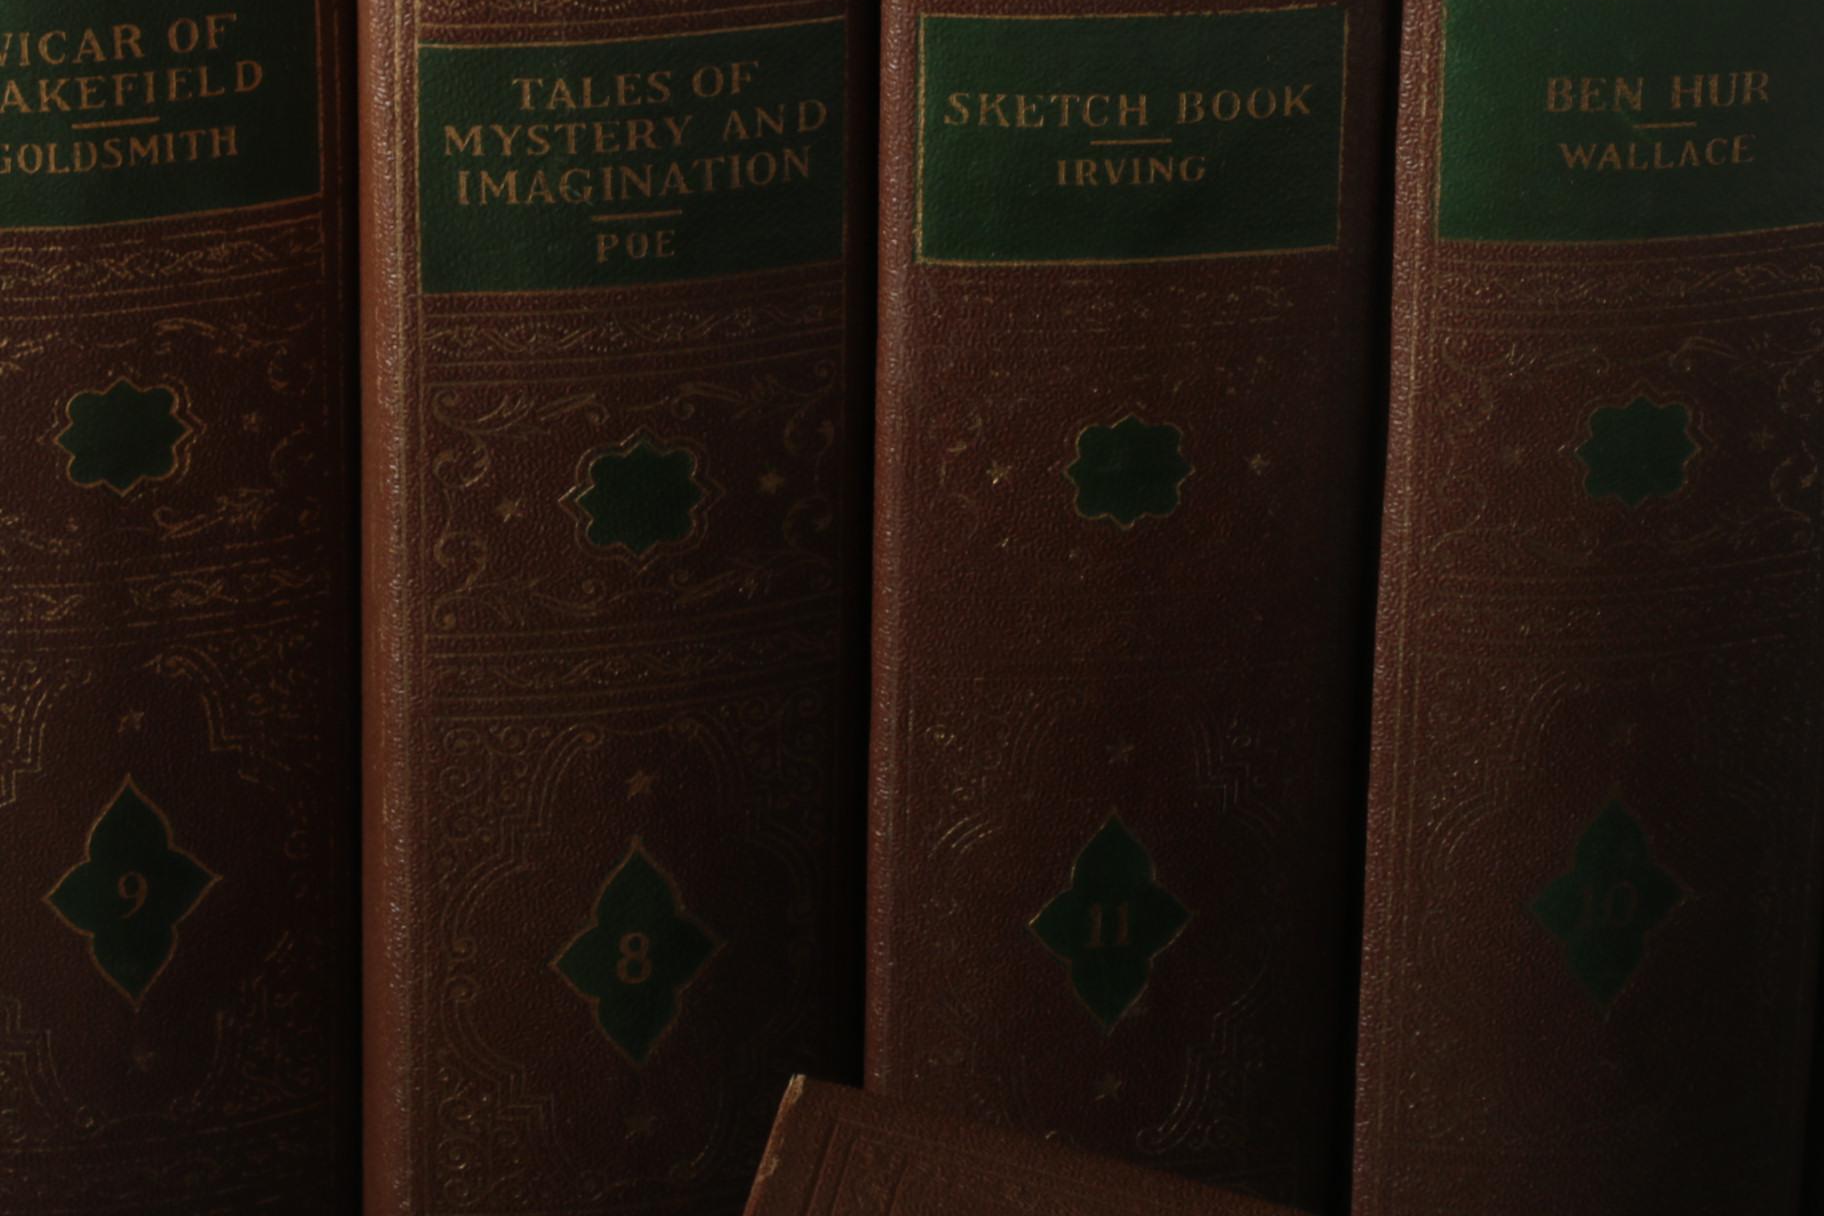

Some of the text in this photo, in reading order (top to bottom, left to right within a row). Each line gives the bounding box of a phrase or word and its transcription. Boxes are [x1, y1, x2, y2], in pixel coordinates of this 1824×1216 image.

[167, 10, 238, 54] OF
[0, 60, 264, 114] AKEFIELD
[512, 60, 760, 111] TALES OF
[943, 84, 1313, 129] SKETCH BOOK
[1545, 69, 1770, 113] BEN HUR
[443, 99, 829, 157] MYSTERY AND
[457, 145, 813, 206] IMAGINATION
[1056, 155, 1207, 186] IRVING
[1558, 133, 1757, 172] WALLACE
[596, 229, 676, 263] POE
[117, 870, 148, 920] 9
[1086, 902, 1130, 948] 11
[616, 931, 653, 984] 8
